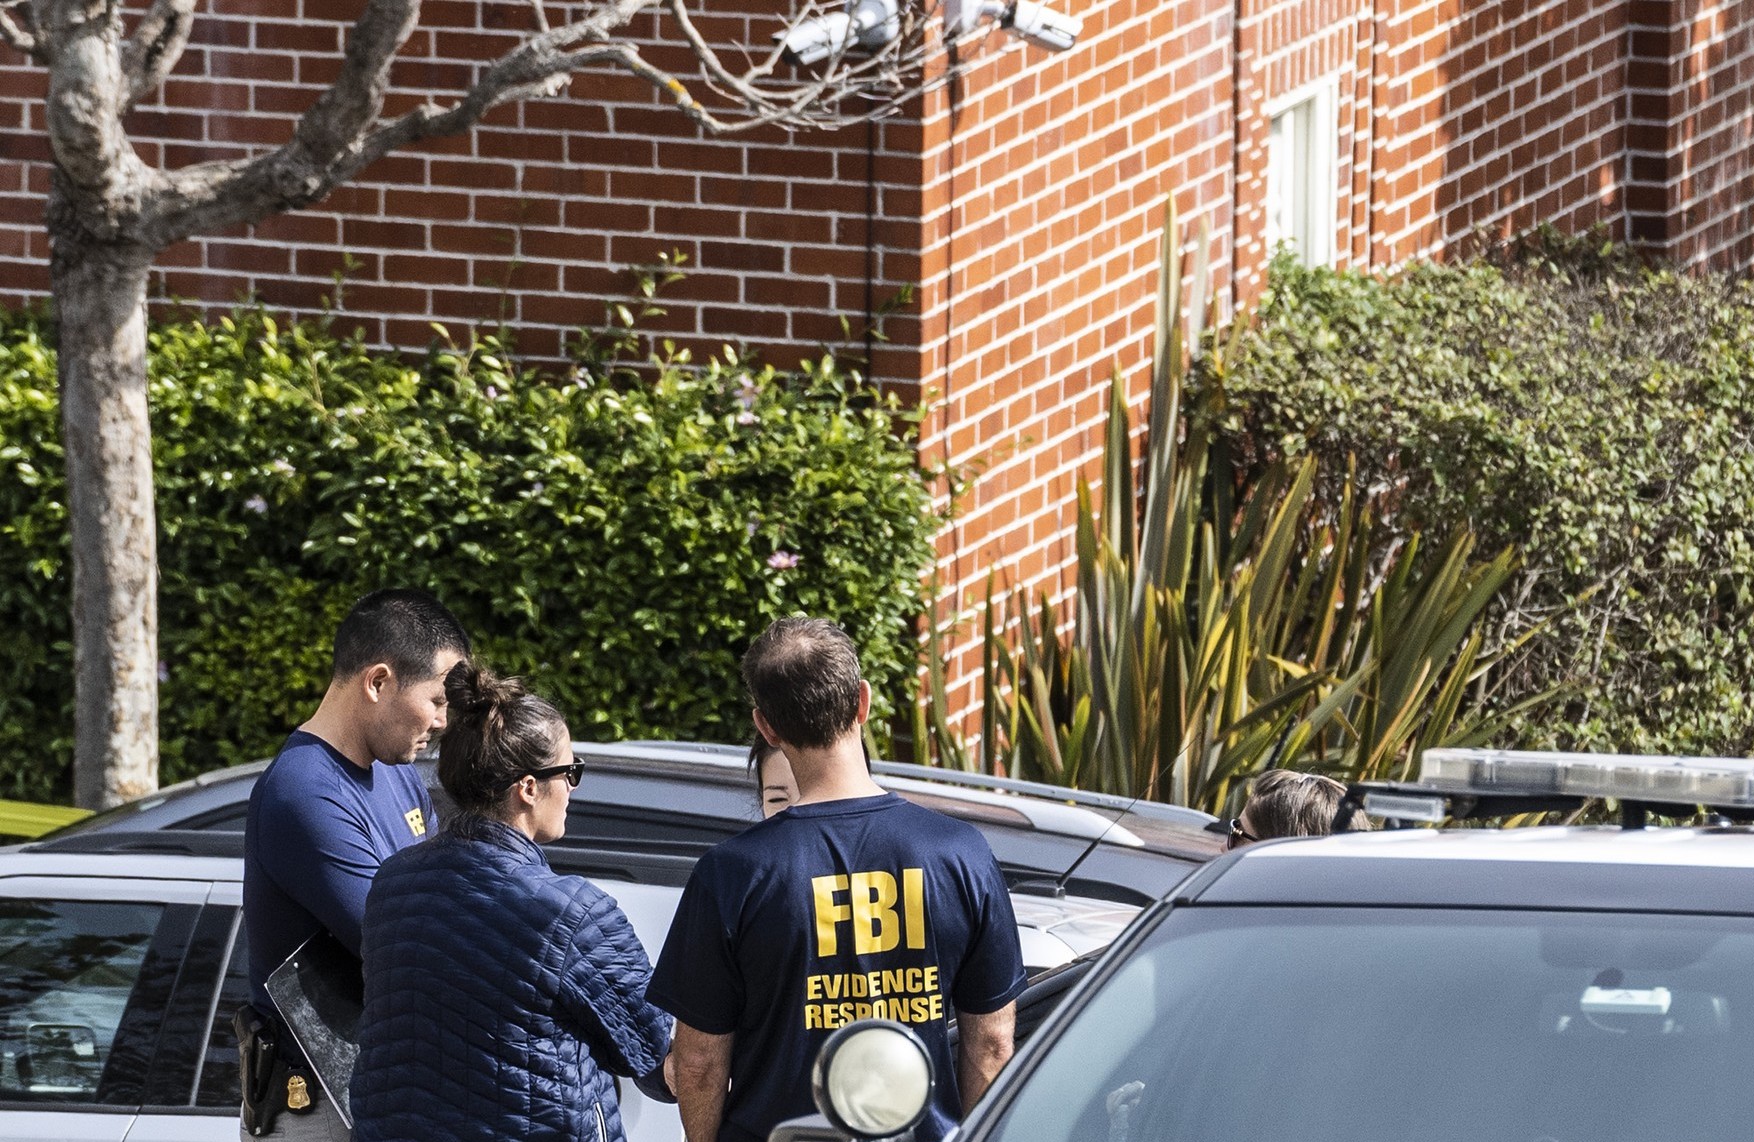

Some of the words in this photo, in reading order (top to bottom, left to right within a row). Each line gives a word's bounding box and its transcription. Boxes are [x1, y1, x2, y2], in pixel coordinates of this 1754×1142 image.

[811, 868, 926, 957] FBI
[807, 966, 939, 1000] EVIDENCE
[805, 994, 943, 1030] RESPONSE
